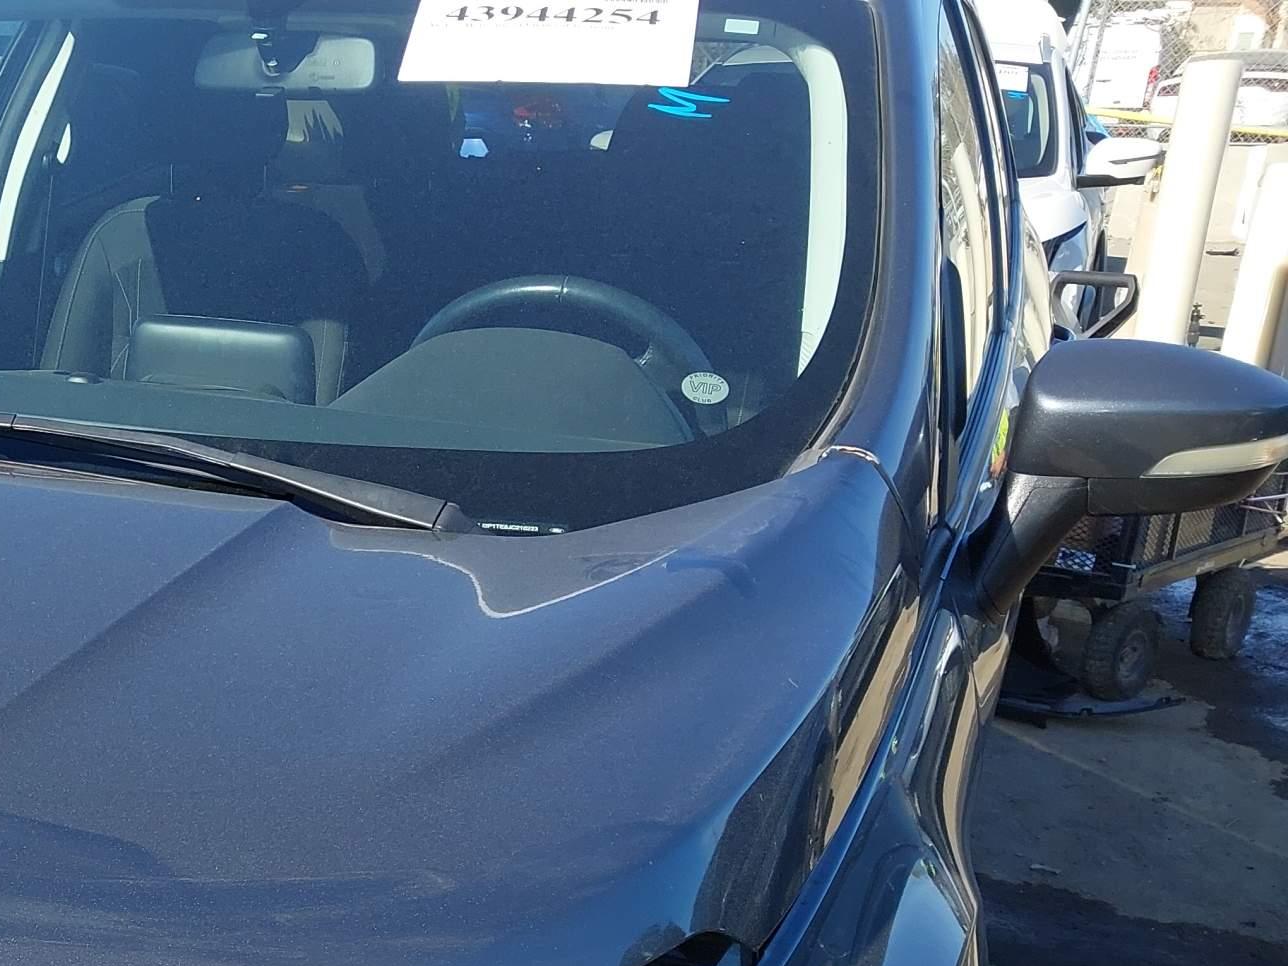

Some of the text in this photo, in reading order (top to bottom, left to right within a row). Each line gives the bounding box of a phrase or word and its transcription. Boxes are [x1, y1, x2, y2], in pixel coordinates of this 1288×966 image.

[446, 6, 660, 25] 43944254
[689, 373, 725, 384] PRIORITY
[689, 380, 722, 395] VIP
